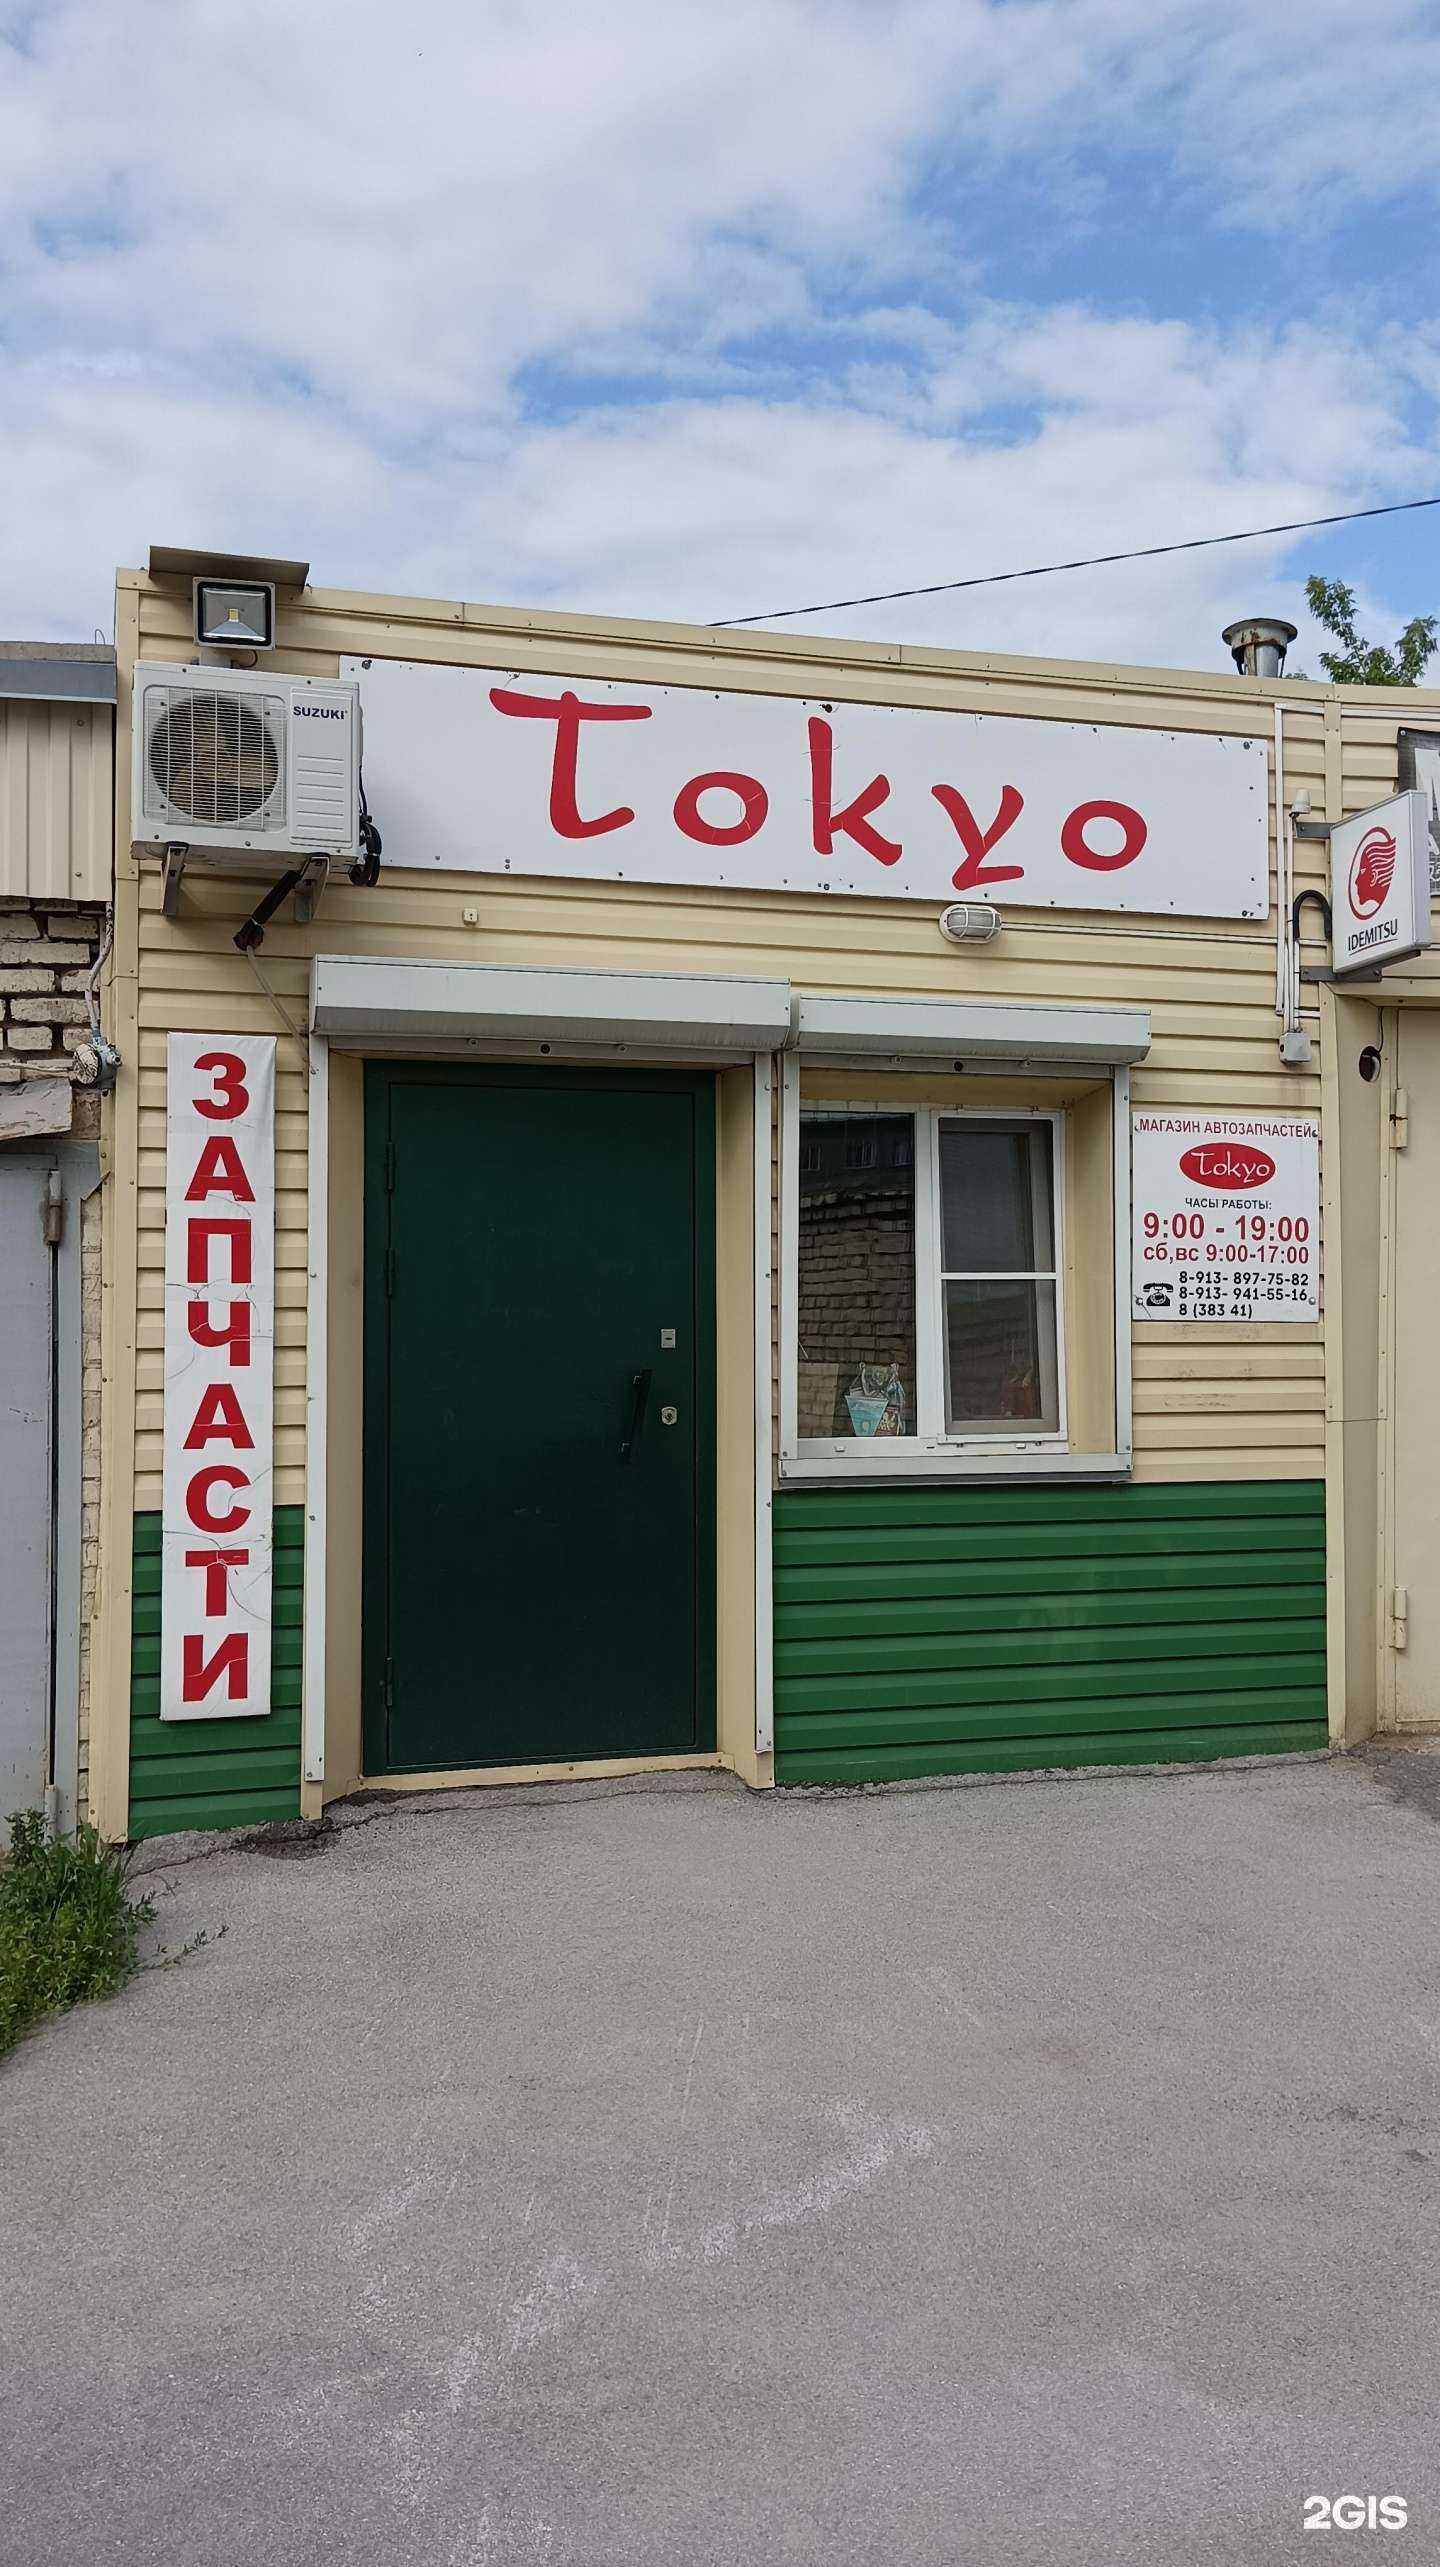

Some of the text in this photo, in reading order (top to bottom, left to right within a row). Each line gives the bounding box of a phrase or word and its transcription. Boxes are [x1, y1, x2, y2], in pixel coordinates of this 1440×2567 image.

[293, 705, 345, 720] SUZUKI
[489, 687, 1148, 891] Tokyo
[1347, 918, 1398, 951] IDEMITSU
[1139, 1118, 1311, 1138] МАГАЗИН АВТОЗАПЧАСТЕЙ
[1191, 1151, 1270, 1183] Tokyo
[1185, 1197, 1272, 1210] ЧАСЫ РАБОТЫ:
[1143, 1212, 1205, 1239] 9:00
[1235, 1215, 1309, 1242] 19:00
[1143, 1242, 1309, 1264] сб,вс 9:00-17:00
[1179, 1271, 1309, 1286] 8-913- 897-75-82
[1179, 1287, 1308, 1301] 8-913- 941-55-16
[1179, 1303, 1253, 1318] 8 (383 41)
[183, 1052, 256, 1702] ЗАПЧАСТИ
